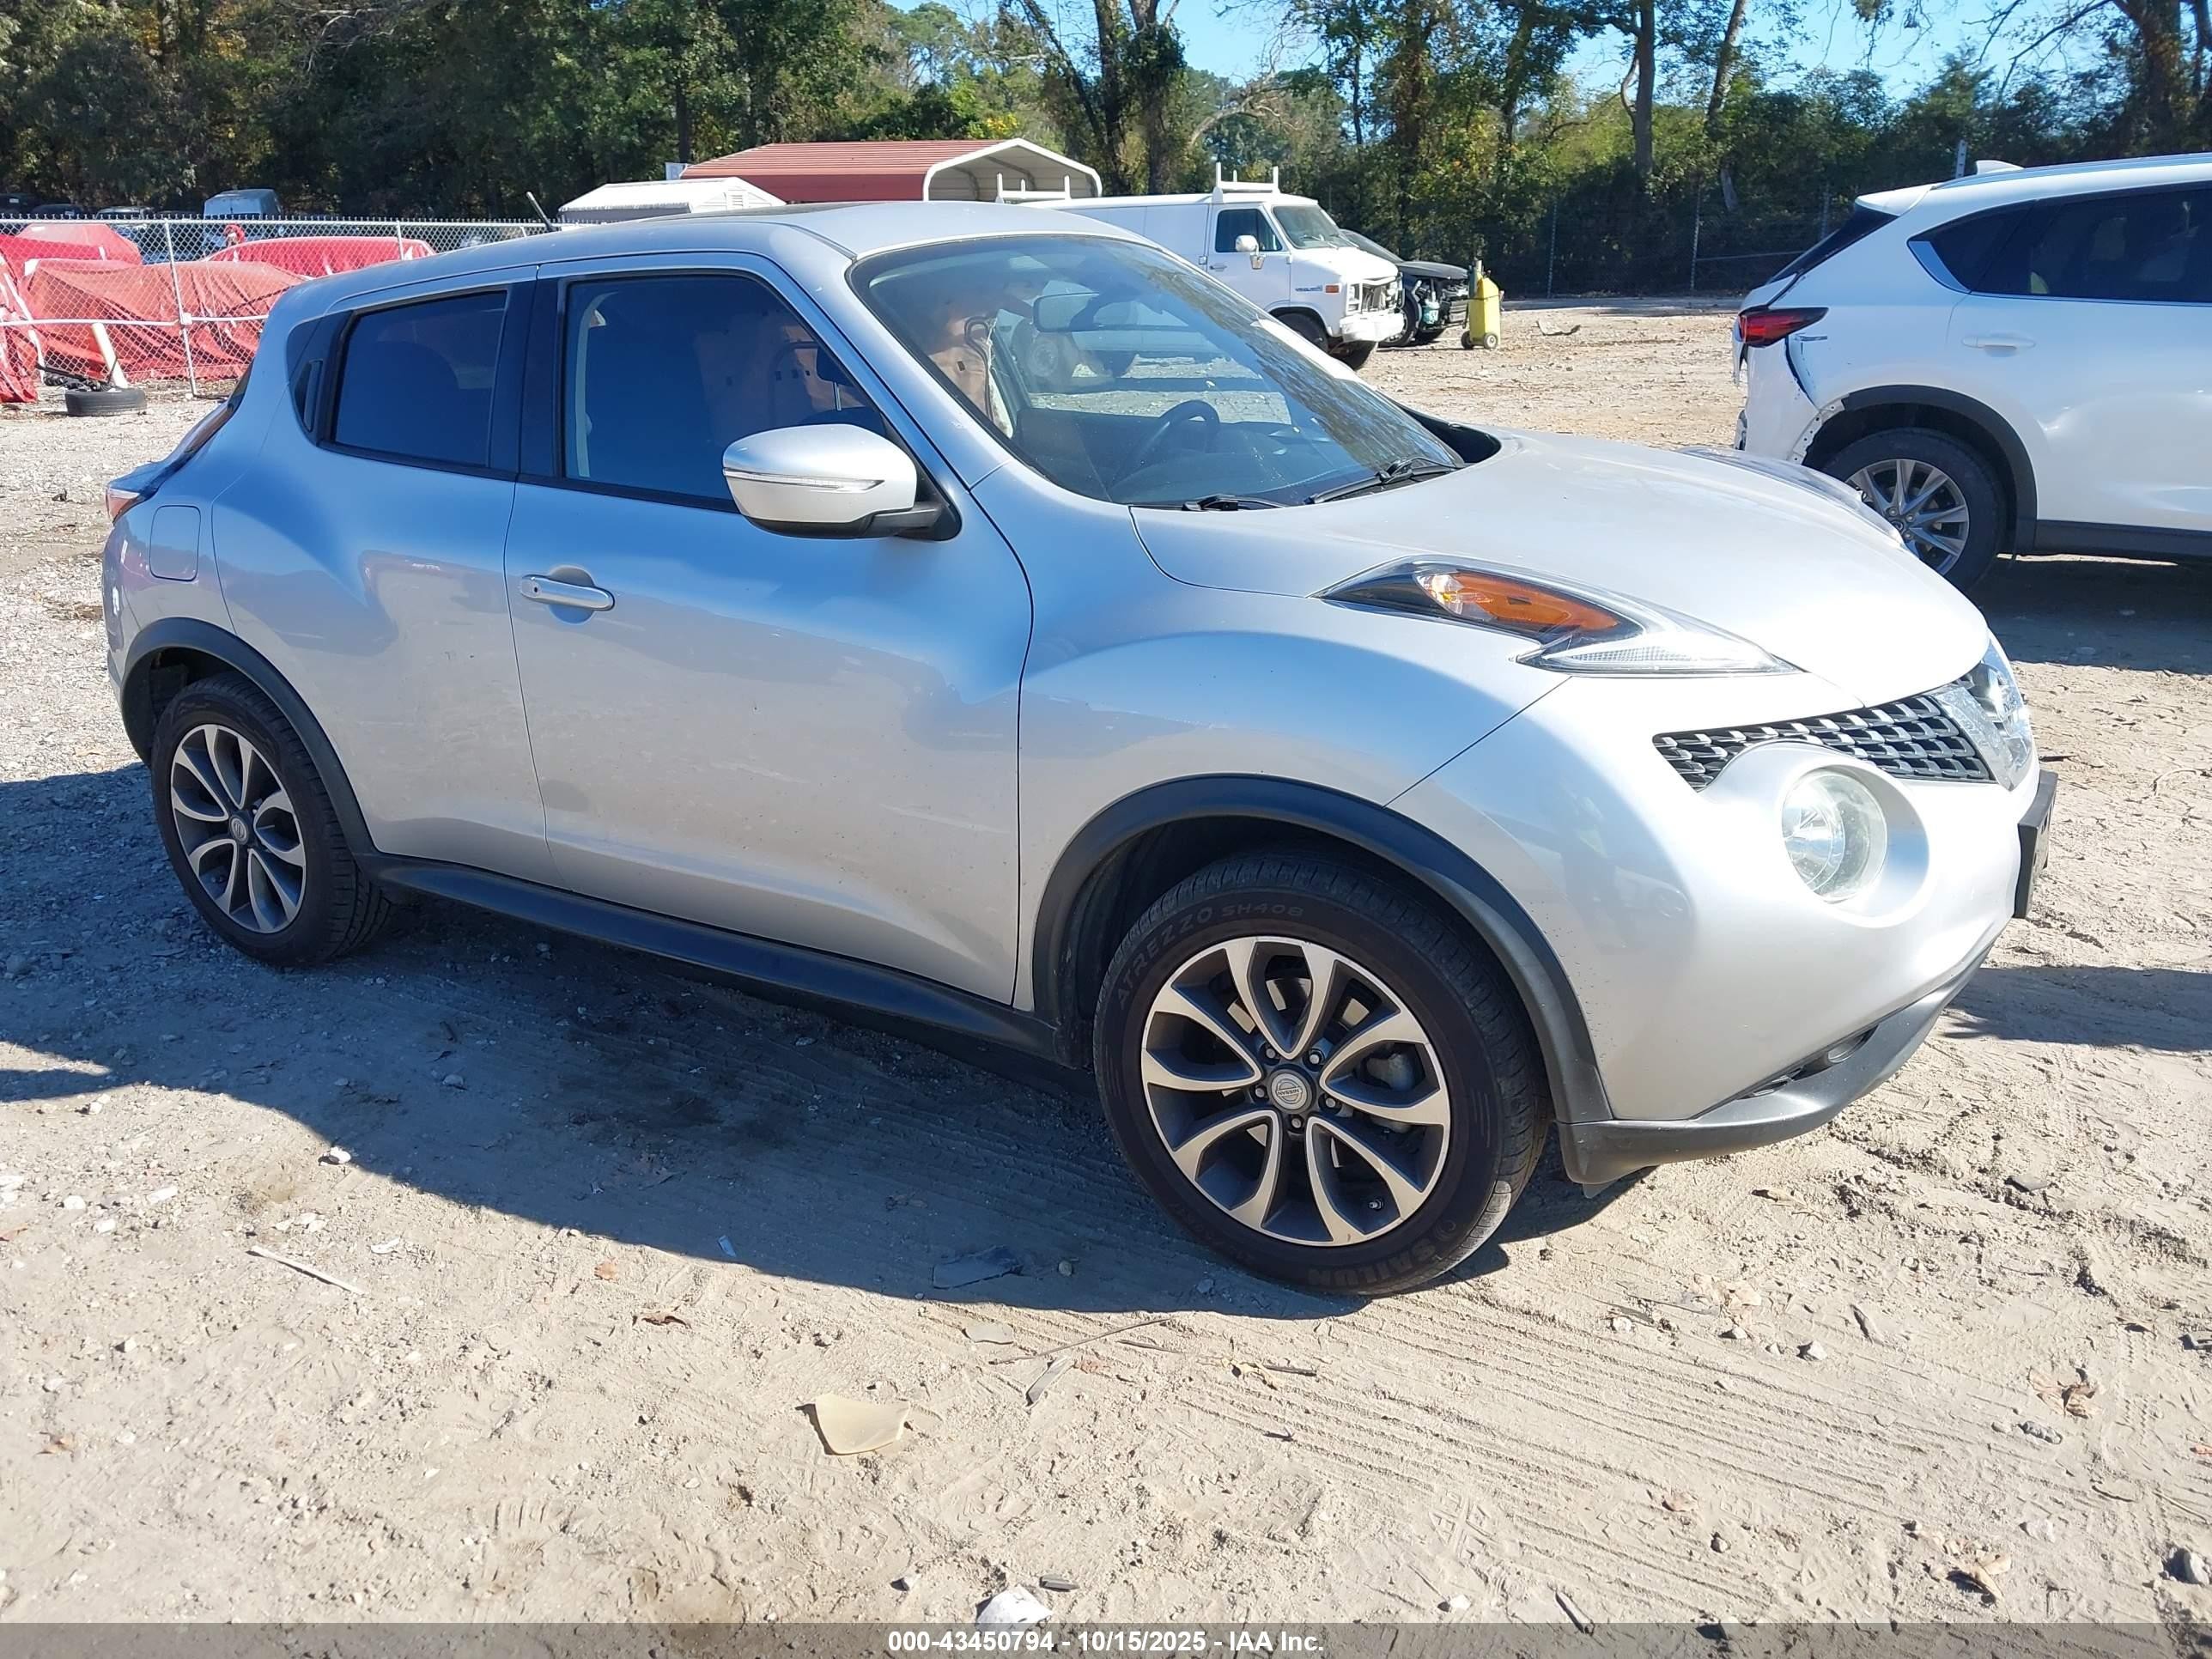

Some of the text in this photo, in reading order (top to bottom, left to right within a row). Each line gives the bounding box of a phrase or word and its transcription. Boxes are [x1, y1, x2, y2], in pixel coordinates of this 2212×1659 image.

[1118, 903, 1304, 1012] ATREZZO SH408
[1307, 1239, 1437, 1286] SAILUN
